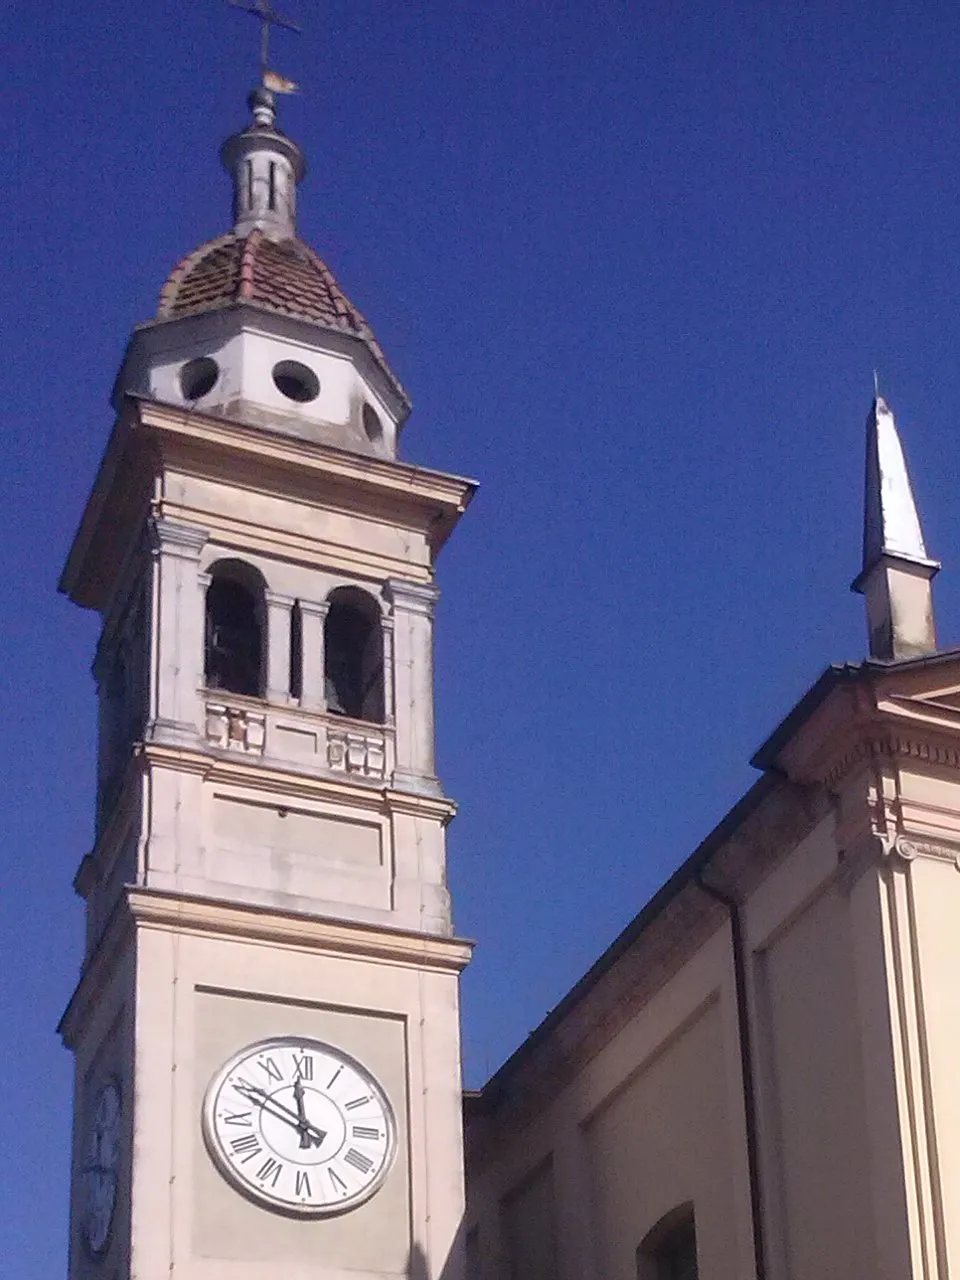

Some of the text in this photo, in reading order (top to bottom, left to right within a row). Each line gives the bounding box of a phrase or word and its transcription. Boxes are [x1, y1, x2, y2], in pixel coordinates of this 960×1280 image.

[292, 1054, 313, 1081] XII
[345, 1096, 370, 1111] II
[352, 1126, 379, 1140] III
[256, 1158, 283, 1188] VII
[295, 1170, 311, 1197] VI
[327, 1167, 347, 1193] V
